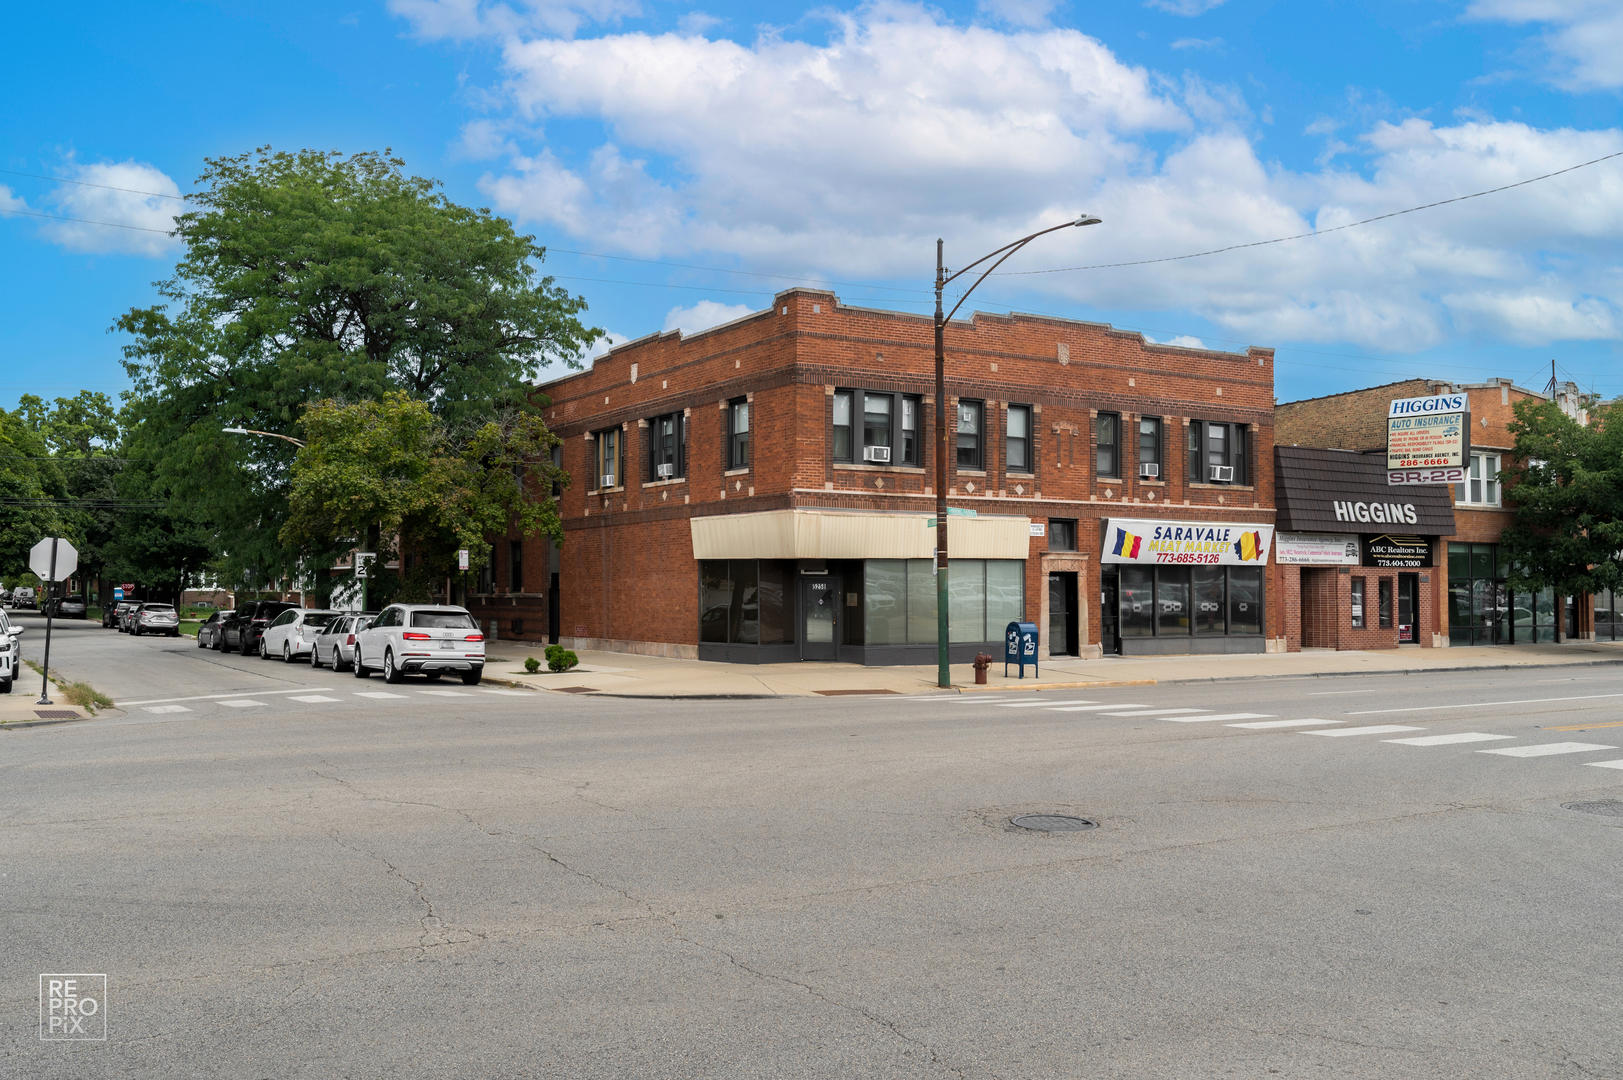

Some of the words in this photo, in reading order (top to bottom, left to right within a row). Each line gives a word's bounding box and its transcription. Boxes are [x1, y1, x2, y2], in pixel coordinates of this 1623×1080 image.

[1393, 396, 1462, 414] HIGGINS
[1391, 418, 1411, 428] AUTO
[1414, 415, 1461, 426] INSURANCE
[1400, 458, 1449, 466] 286-6666
[1390, 470, 1462, 483] SR-22
[1333, 501, 1418, 524] HIGGINS
[1154, 526, 1230, 541] SARAVALE
[1148, 540, 1181, 552] MEAT
[1184, 541, 1231, 553] MARKET
[1157, 553, 1220, 563] 773-685-5126
